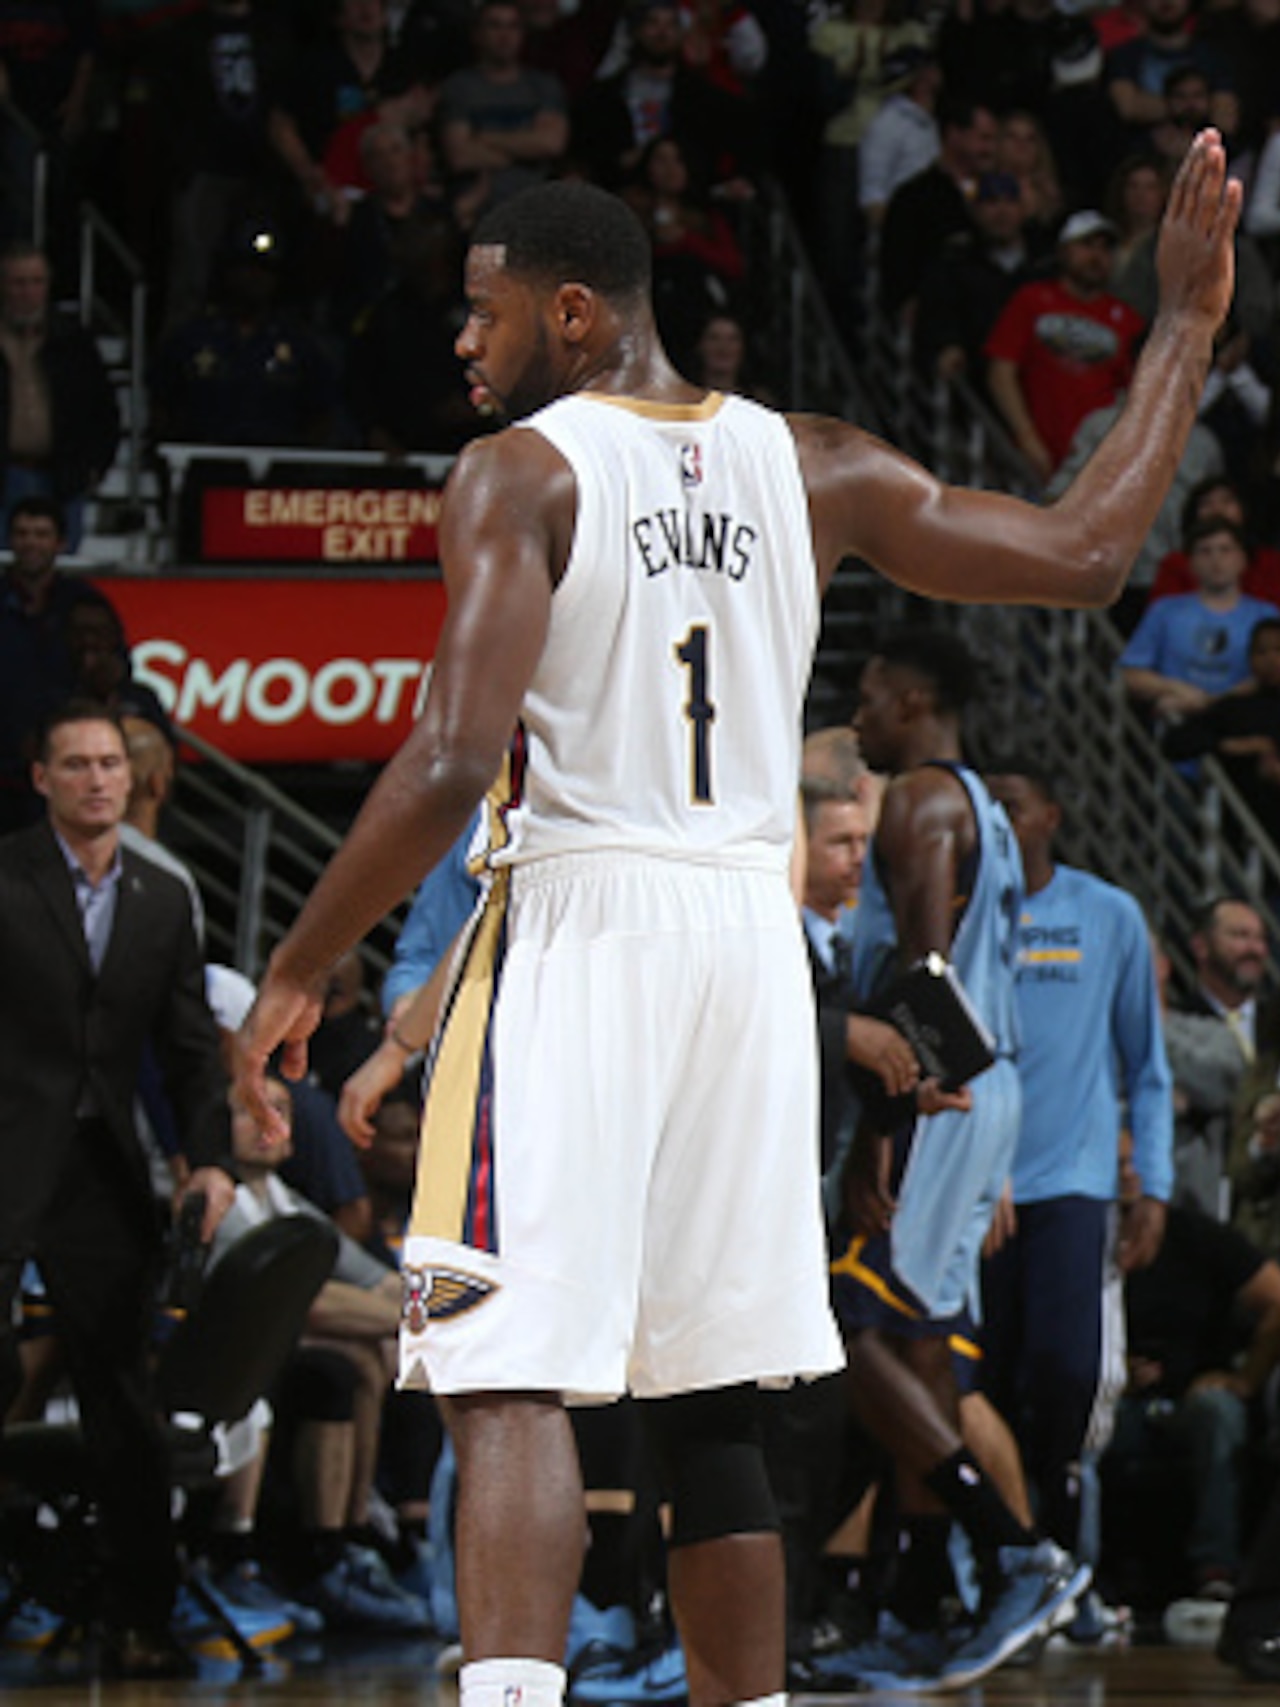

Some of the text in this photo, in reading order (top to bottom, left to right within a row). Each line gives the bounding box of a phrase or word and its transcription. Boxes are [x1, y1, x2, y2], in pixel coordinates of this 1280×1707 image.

[243, 489, 442, 526] EMERGEN
[322, 525, 410, 561] EXIT
[673, 623, 715, 806] 1
